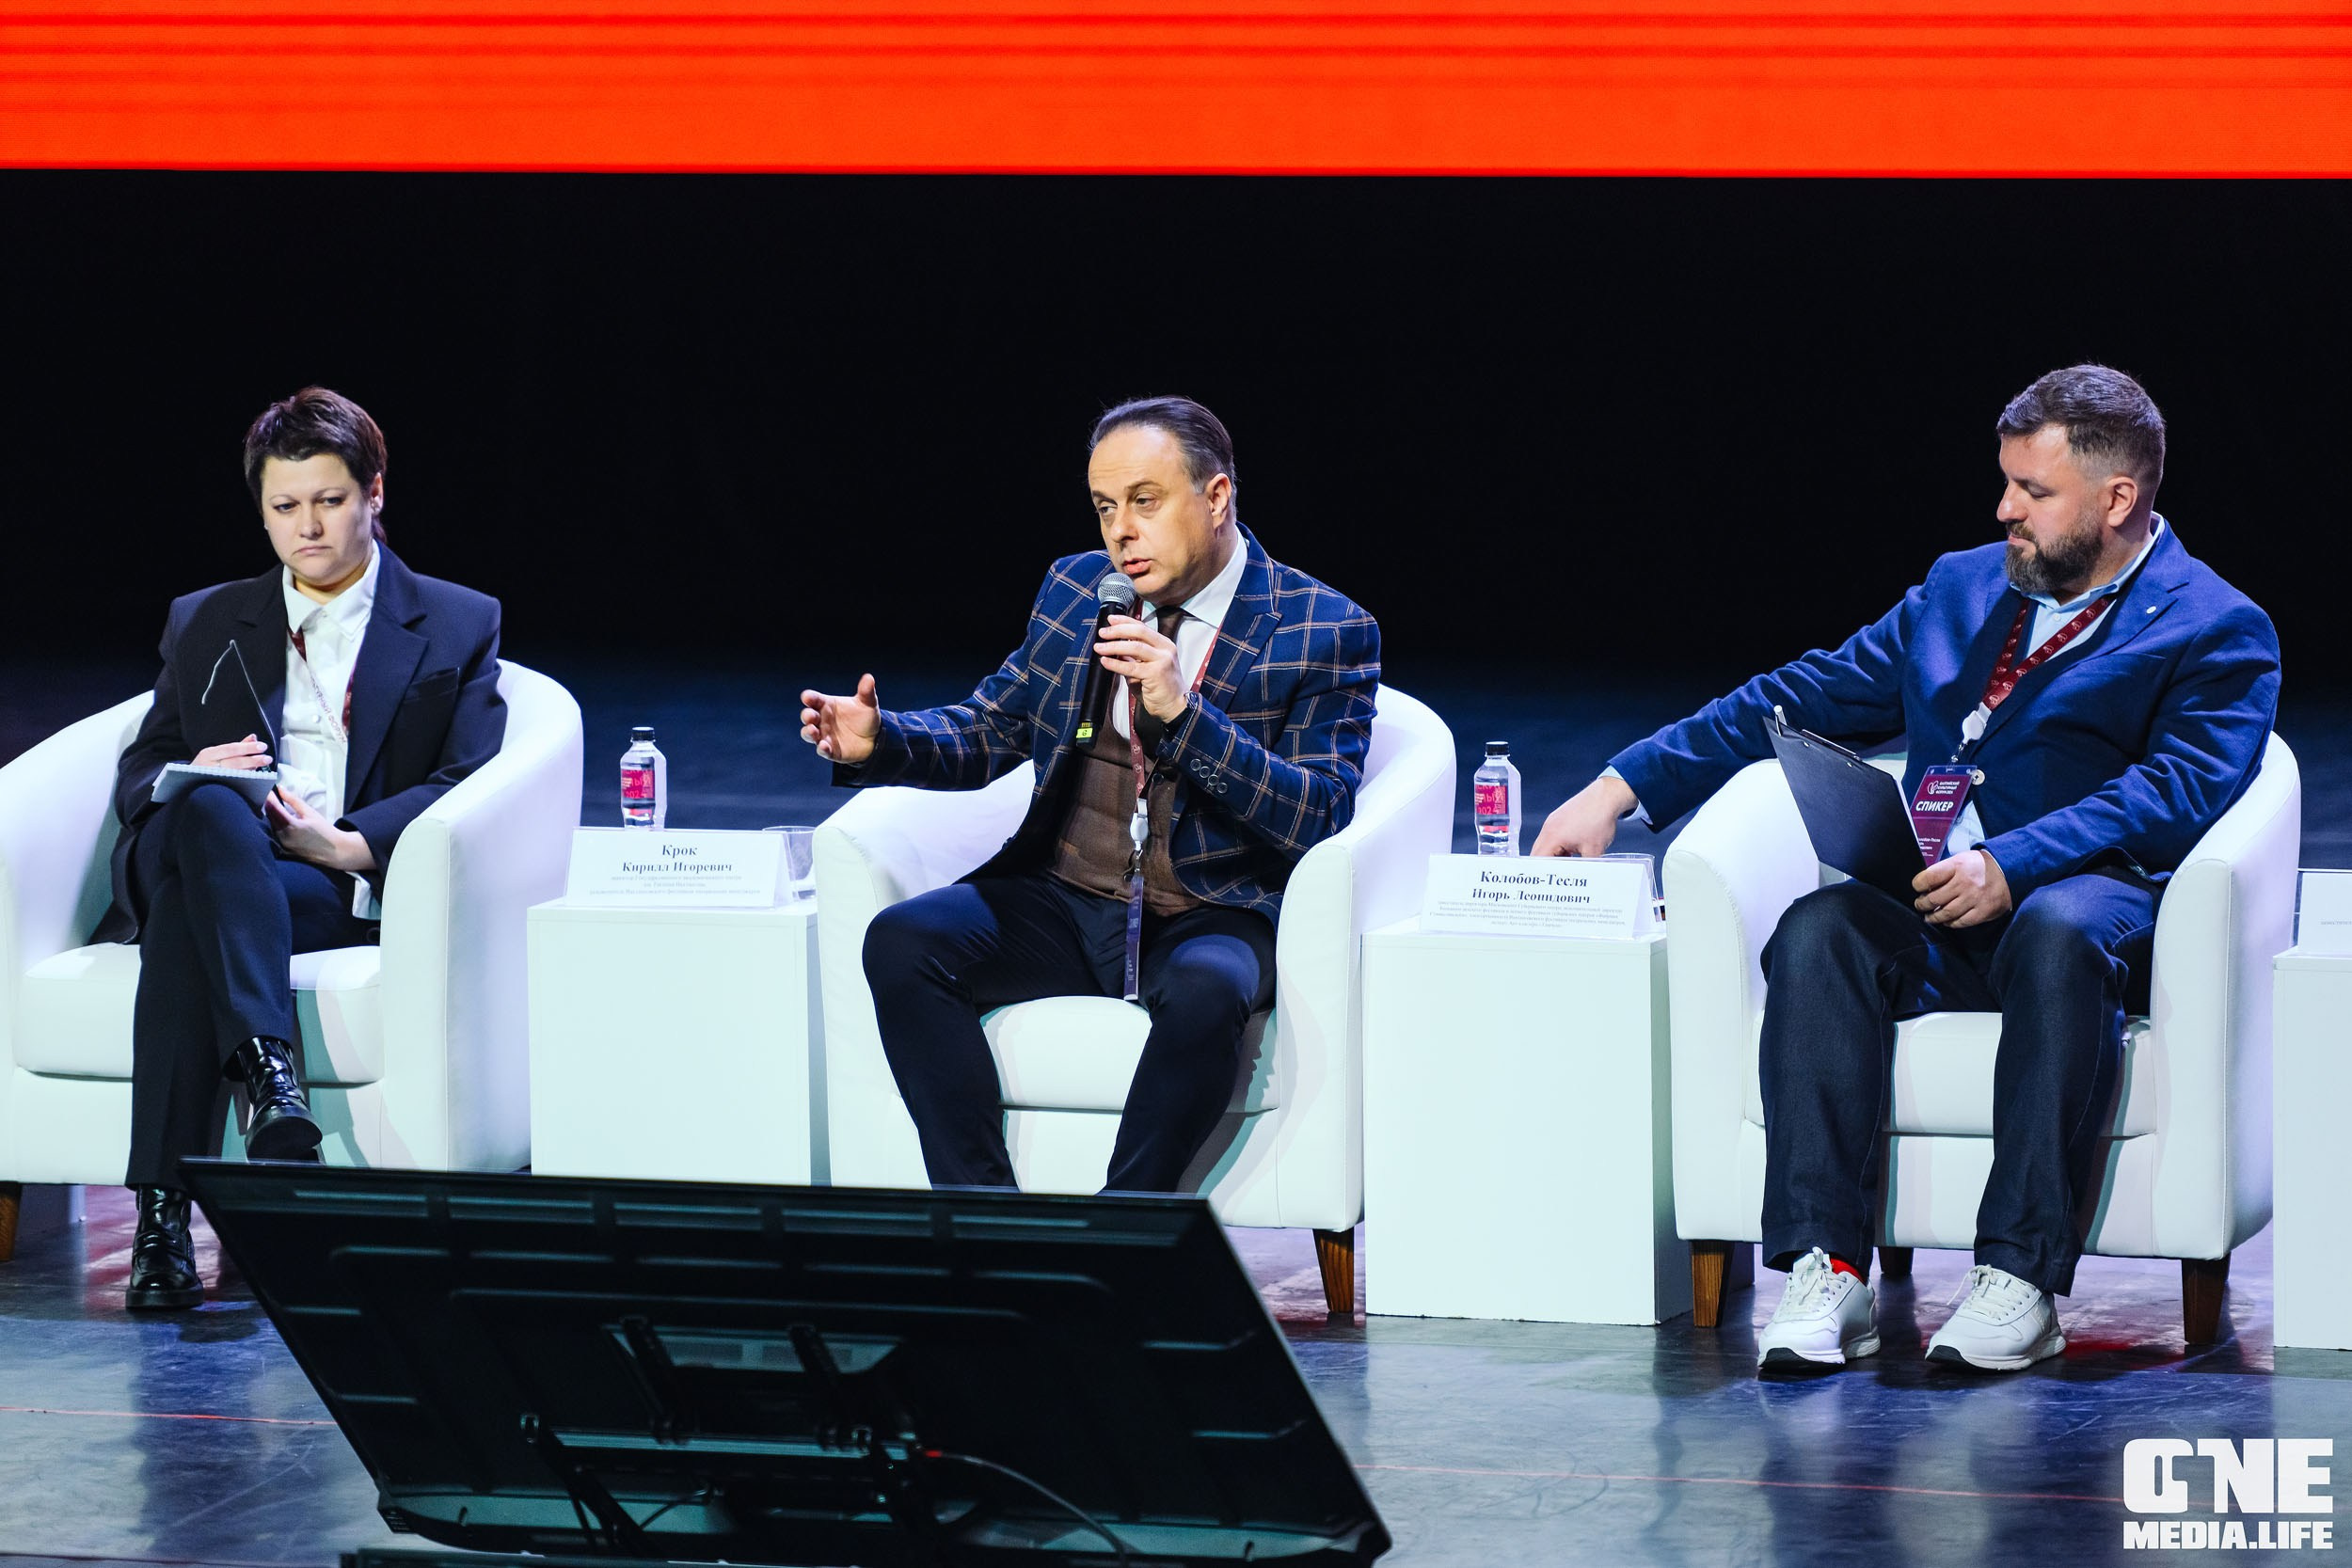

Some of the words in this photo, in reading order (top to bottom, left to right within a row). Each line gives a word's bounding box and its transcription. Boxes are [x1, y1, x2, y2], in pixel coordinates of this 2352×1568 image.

[1915, 801, 1954, 812] СПИКЕР
[661, 845, 698, 858] Крок
[622, 862, 669, 874] Кирилл
[673, 862, 732, 875] Игоревич
[1480, 871, 1588, 887] Колобов-Тесля
[1472, 888, 1510, 900] Игорь
[1513, 890, 1591, 904] Леонидович
